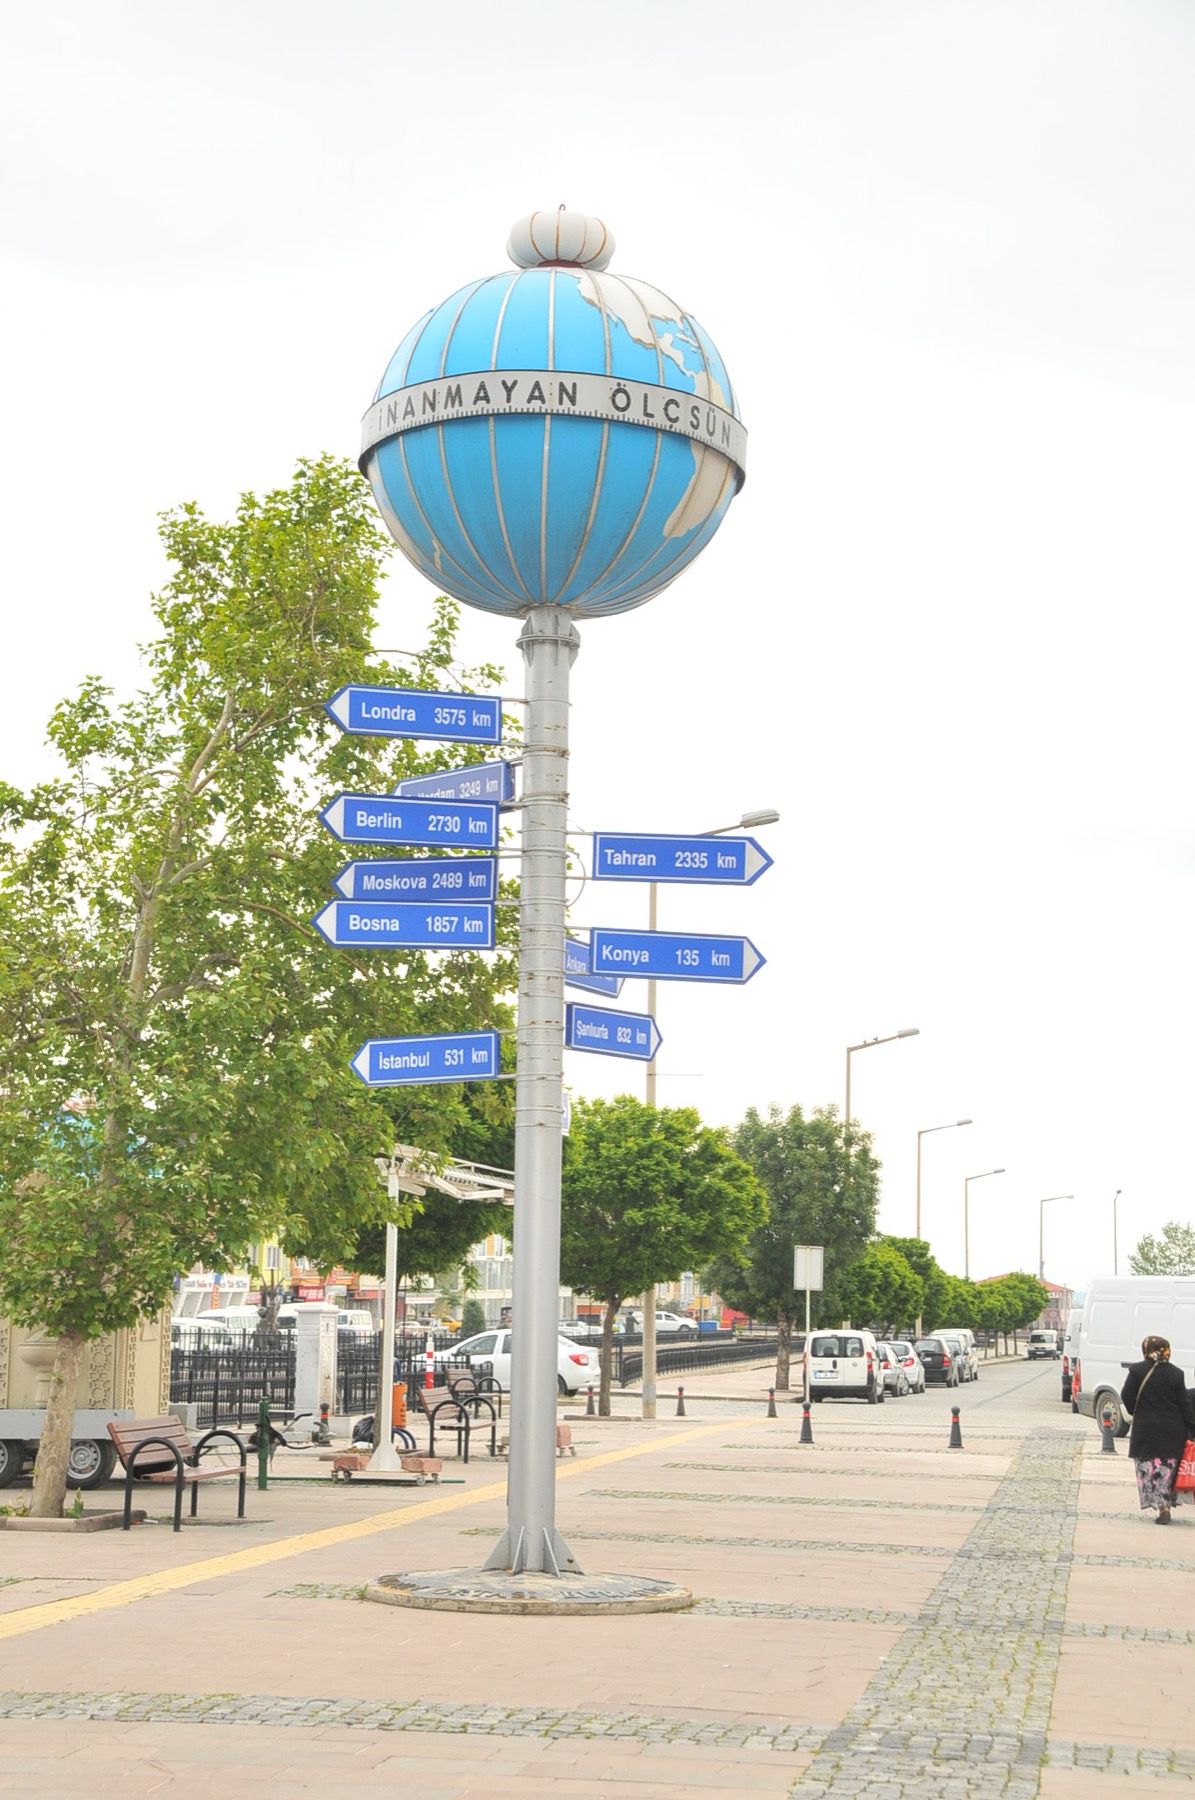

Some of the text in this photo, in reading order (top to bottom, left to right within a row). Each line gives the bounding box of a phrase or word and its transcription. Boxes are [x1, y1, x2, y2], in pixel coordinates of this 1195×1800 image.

[609, 381, 731, 448] ÖLÇSÜN
[361, 702, 492, 727] Londra 3575 km
[459, 780, 481, 799] 3249
[486, 778, 499, 794] km
[356, 811, 488, 834] Berlin 2730 km
[604, 849, 737, 869] Tahran 2335 km
[363, 871, 487, 891] Moskova 2489 km
[349, 914, 484, 933] Bosna 1857 km
[602, 944, 731, 967] Konya 135 km
[616, 1026, 632, 1044] 832
[636, 1028, 647, 1045] km
[379, 1048, 488, 1070] İstanbul 531 km
